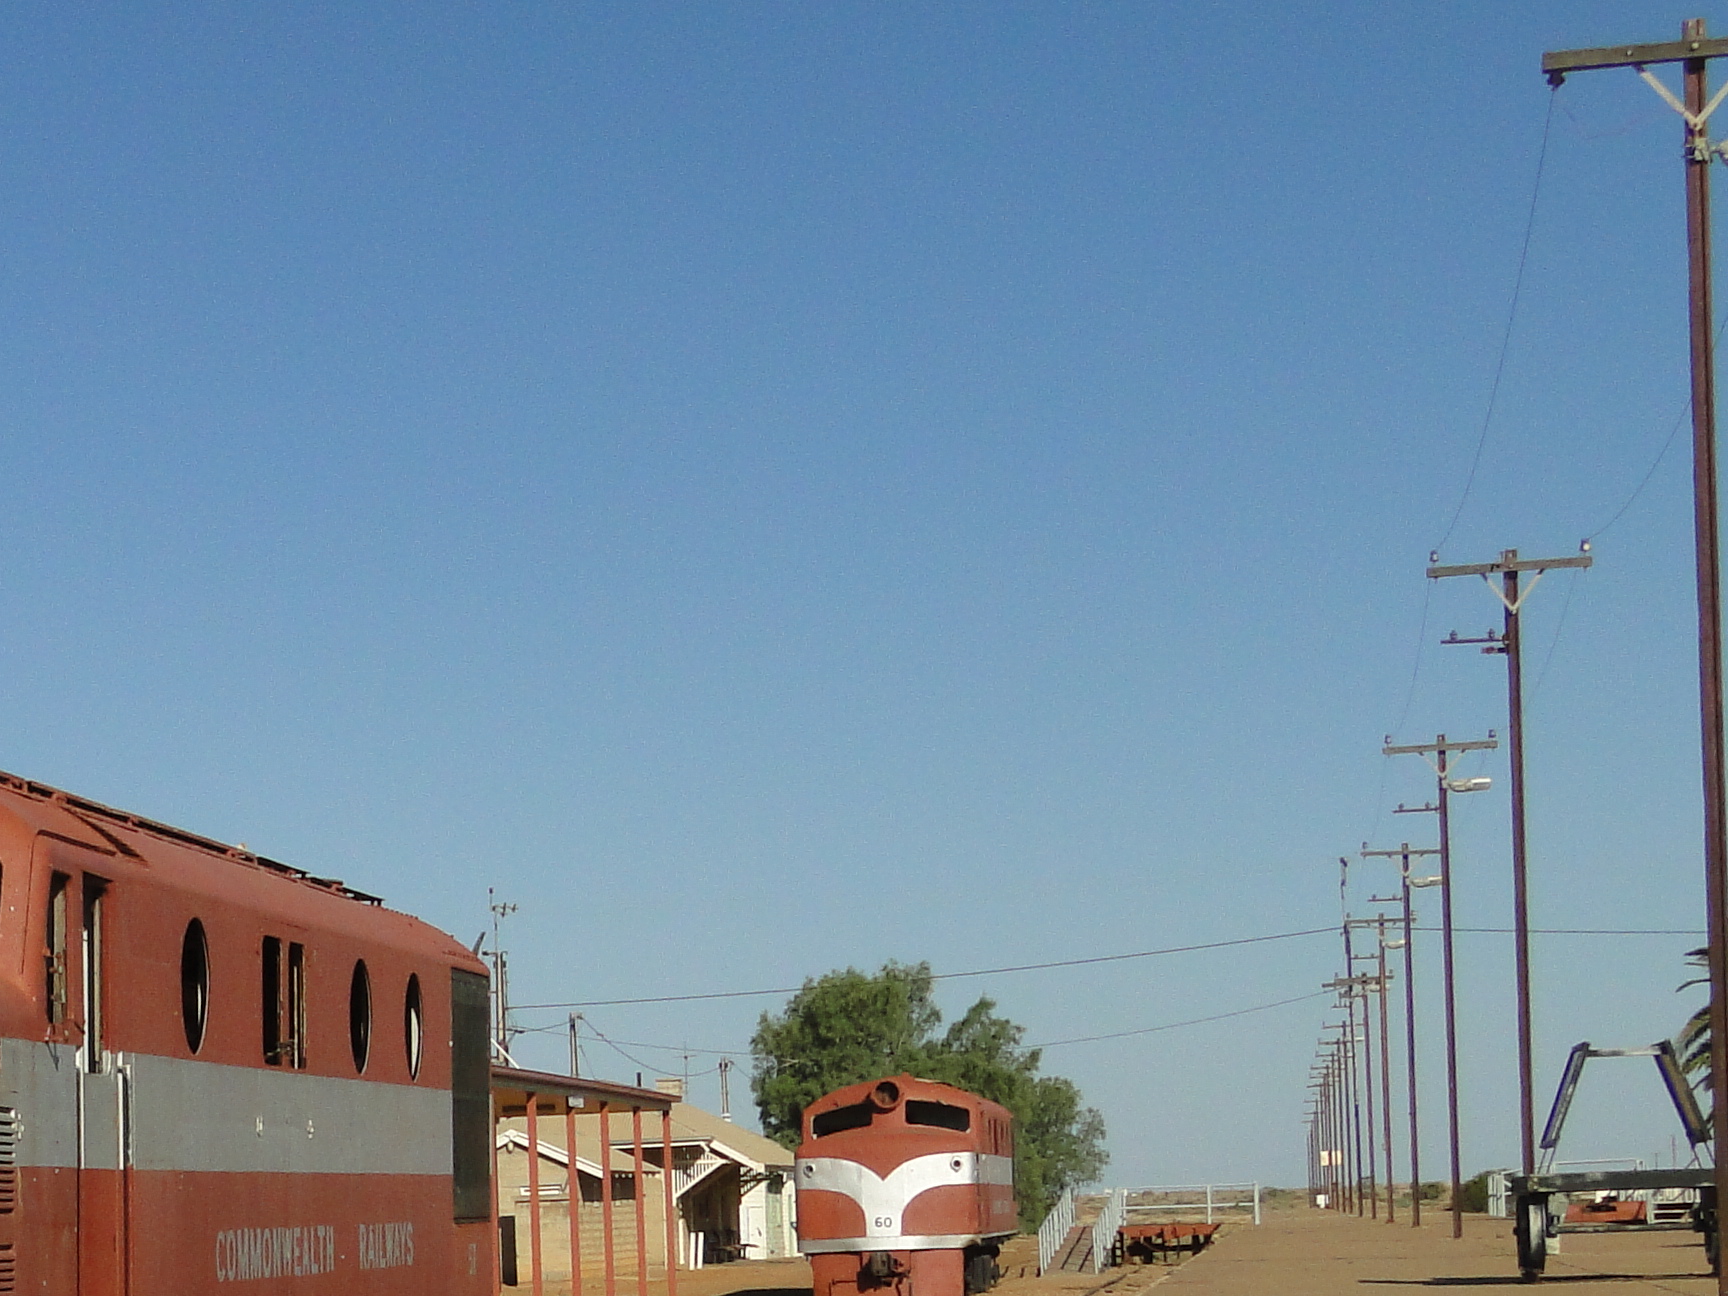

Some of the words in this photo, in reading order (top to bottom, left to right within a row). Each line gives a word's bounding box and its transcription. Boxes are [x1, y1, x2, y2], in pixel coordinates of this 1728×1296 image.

[874, 1216, 893, 1228] 60
[215, 1224, 335, 1283] COMMONWEALTH
[358, 1221, 415, 1270] RAILWAYS
